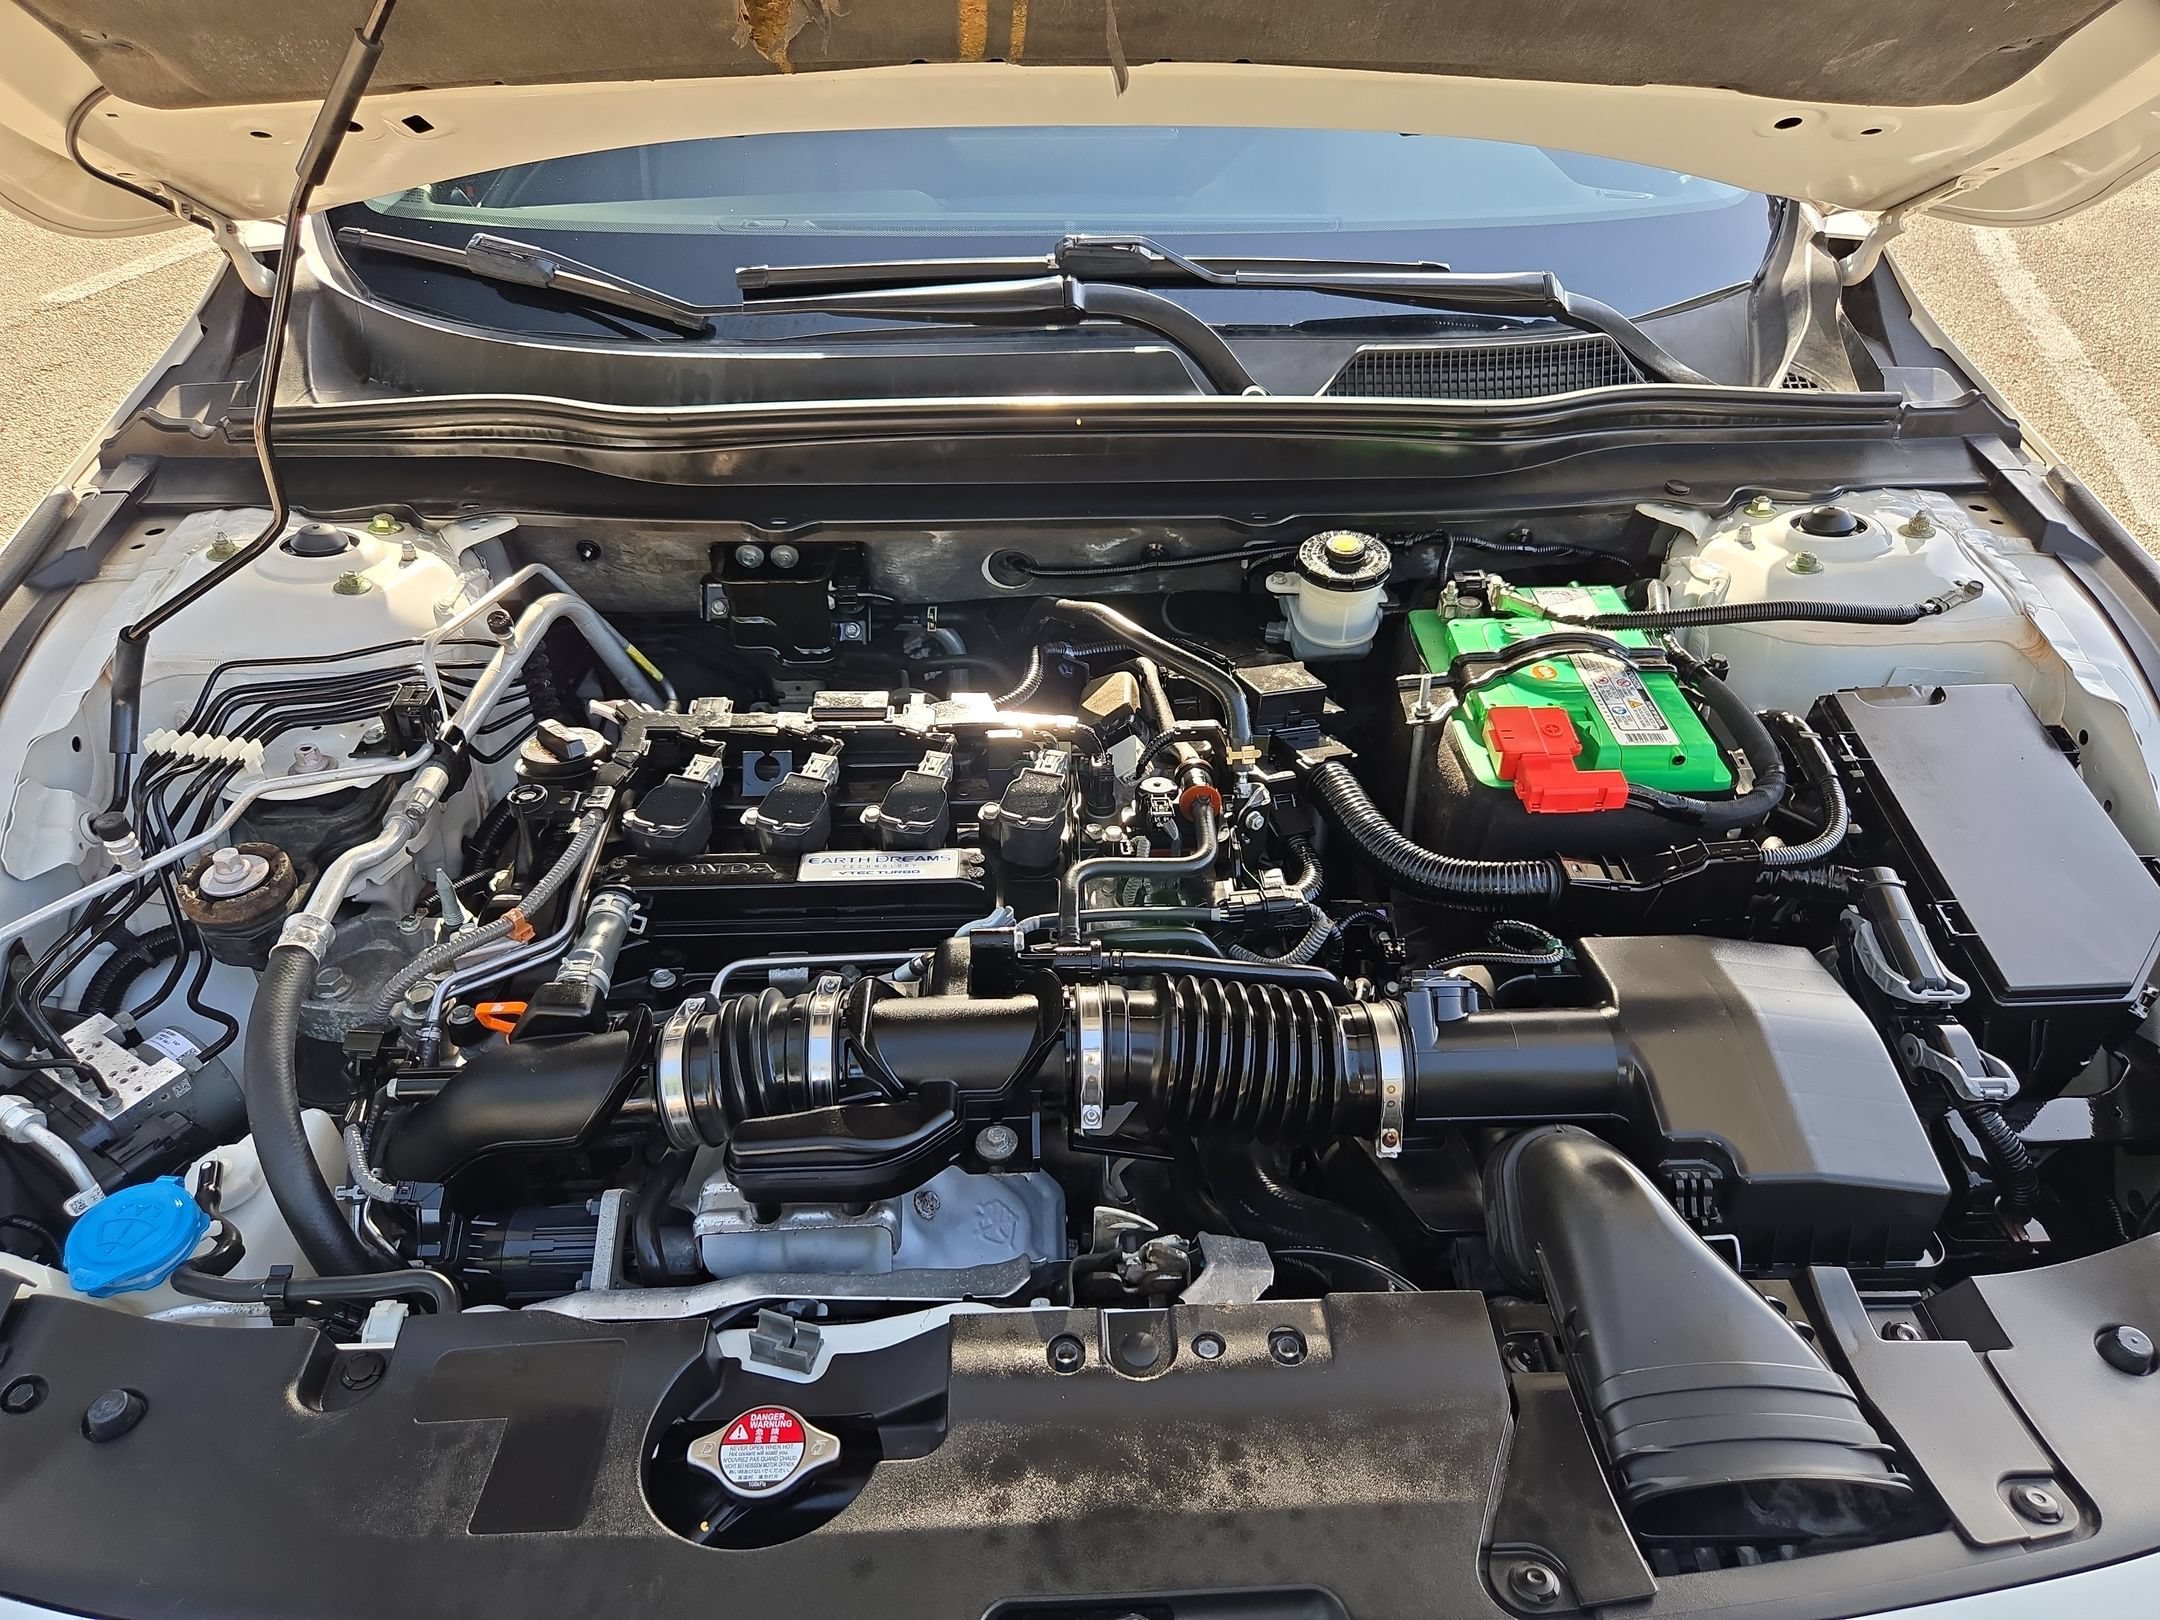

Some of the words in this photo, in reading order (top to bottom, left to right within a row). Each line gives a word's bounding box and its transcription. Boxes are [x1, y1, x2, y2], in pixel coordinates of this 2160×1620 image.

[808, 856, 871, 865] EARTH
[875, 855, 951, 863] DREAMS
[648, 862, 777, 875] HONDA
[750, 1413, 785, 1421] DANGER
[750, 1420, 793, 1429] WARNUNG
